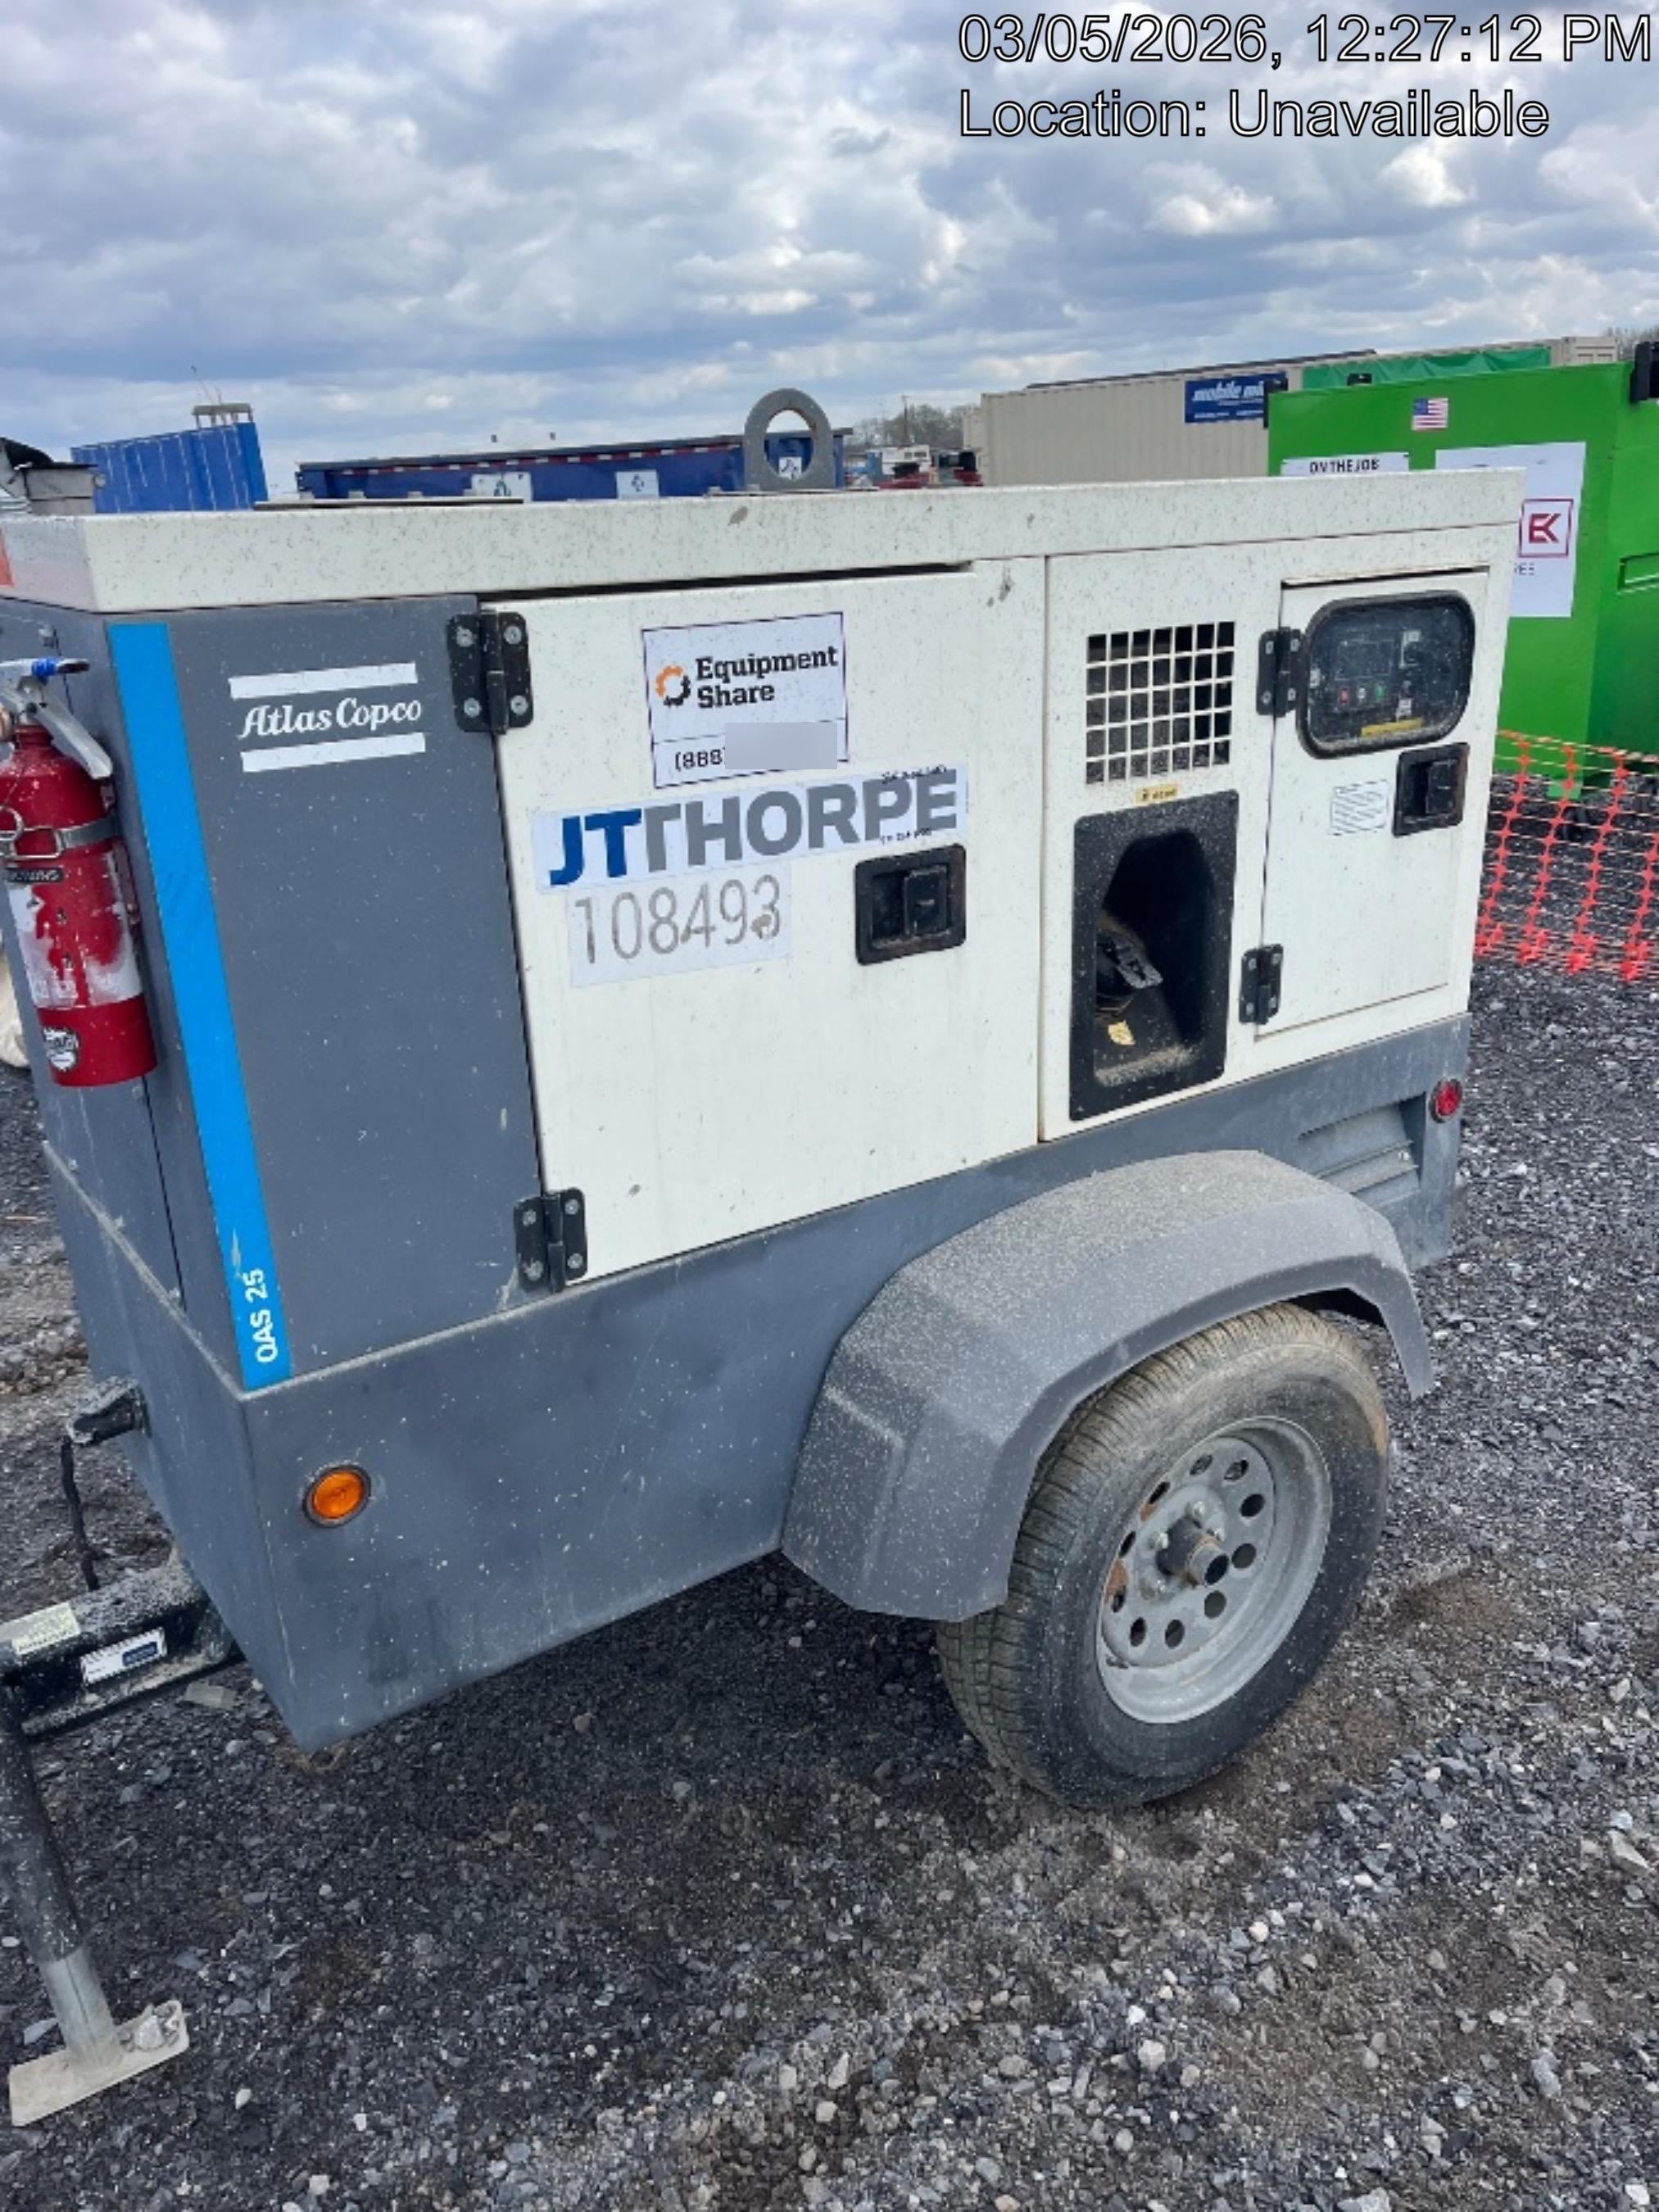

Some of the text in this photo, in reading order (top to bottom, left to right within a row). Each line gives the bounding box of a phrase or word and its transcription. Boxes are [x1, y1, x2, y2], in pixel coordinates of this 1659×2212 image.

[1192, 380, 1264, 401] mobile mi
[696, 646, 839, 683] Equipment
[697, 684, 775, 709] Share
[237, 697, 422, 740] Atlas Copco
[675, 746, 726, 771] (888
[574, 874, 781, 964] 108493
[243, 1268, 279, 1363] QAS 25
